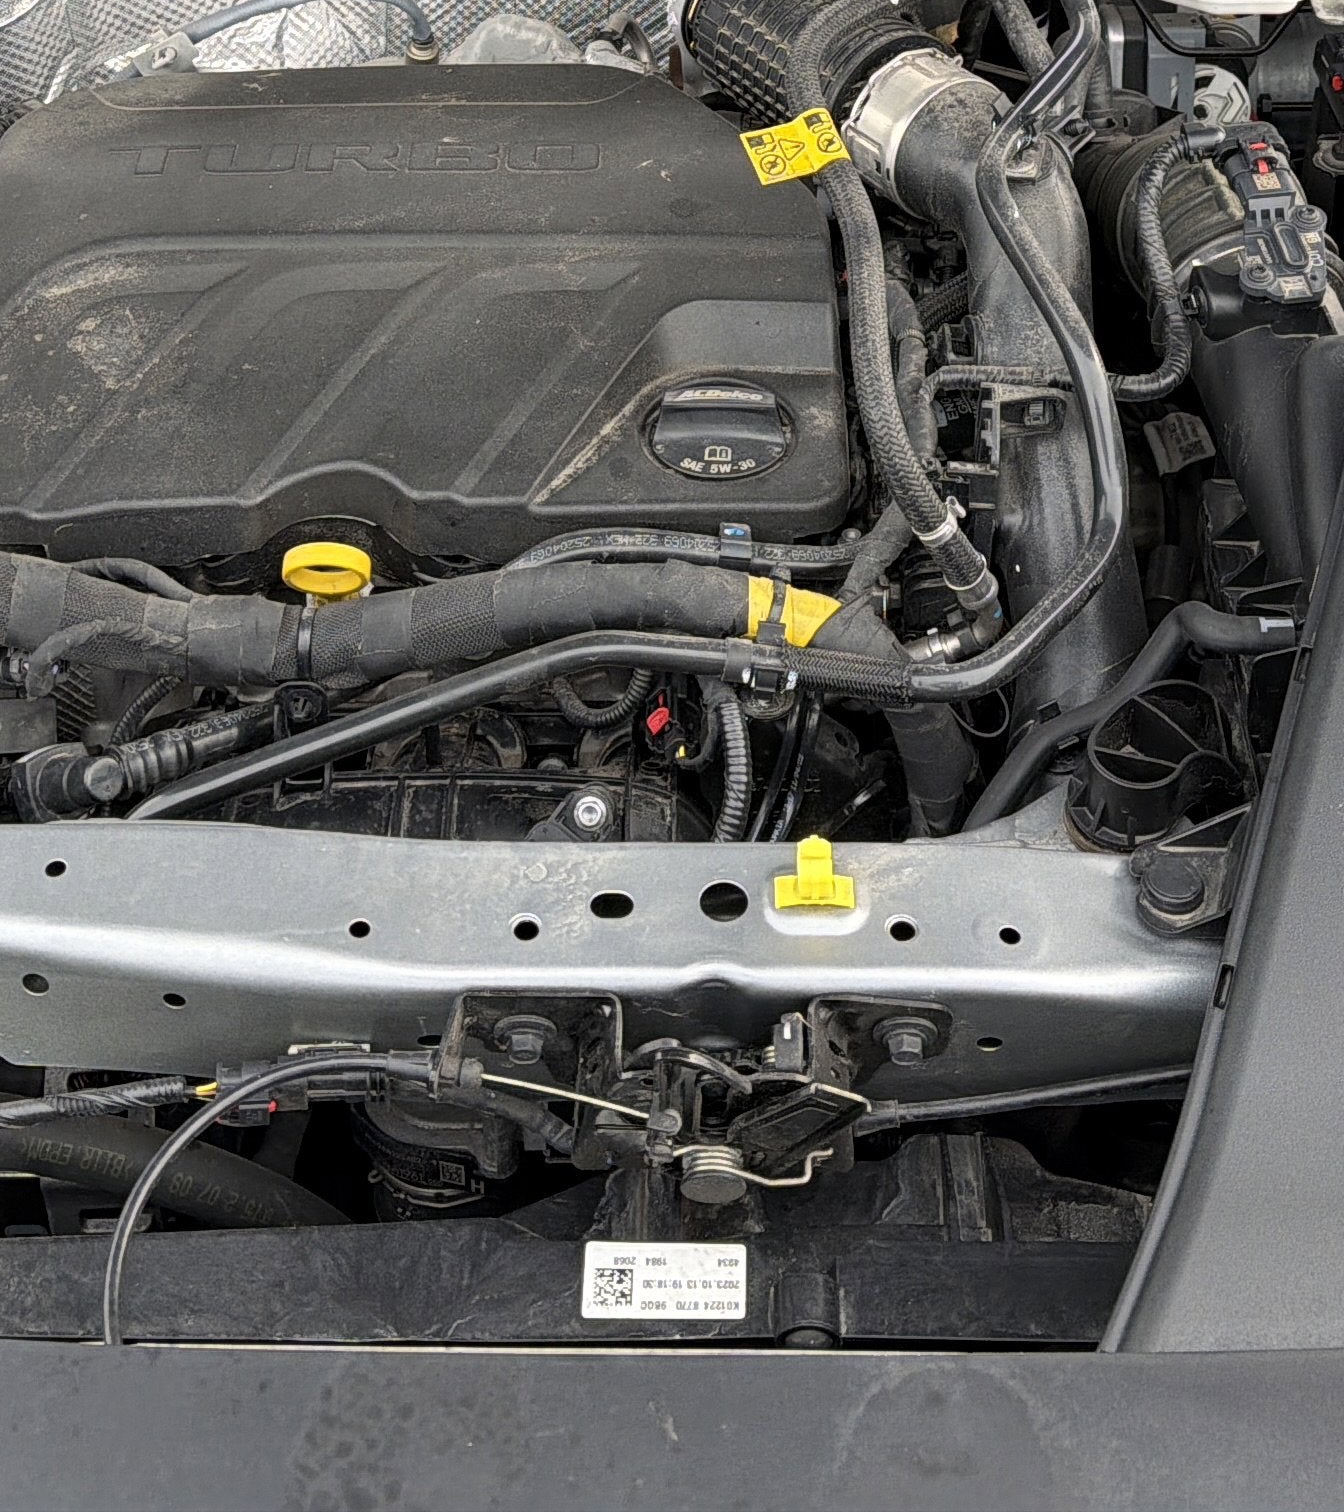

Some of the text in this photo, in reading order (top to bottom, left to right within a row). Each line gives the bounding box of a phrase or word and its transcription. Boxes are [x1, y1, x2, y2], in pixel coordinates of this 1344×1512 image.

[108, 141, 602, 175] TURBO
[673, 389, 764, 402] ACDelco
[680, 457, 756, 474] SAE 5W-30
[686, 1279, 740, 1289] 2023.10.13
